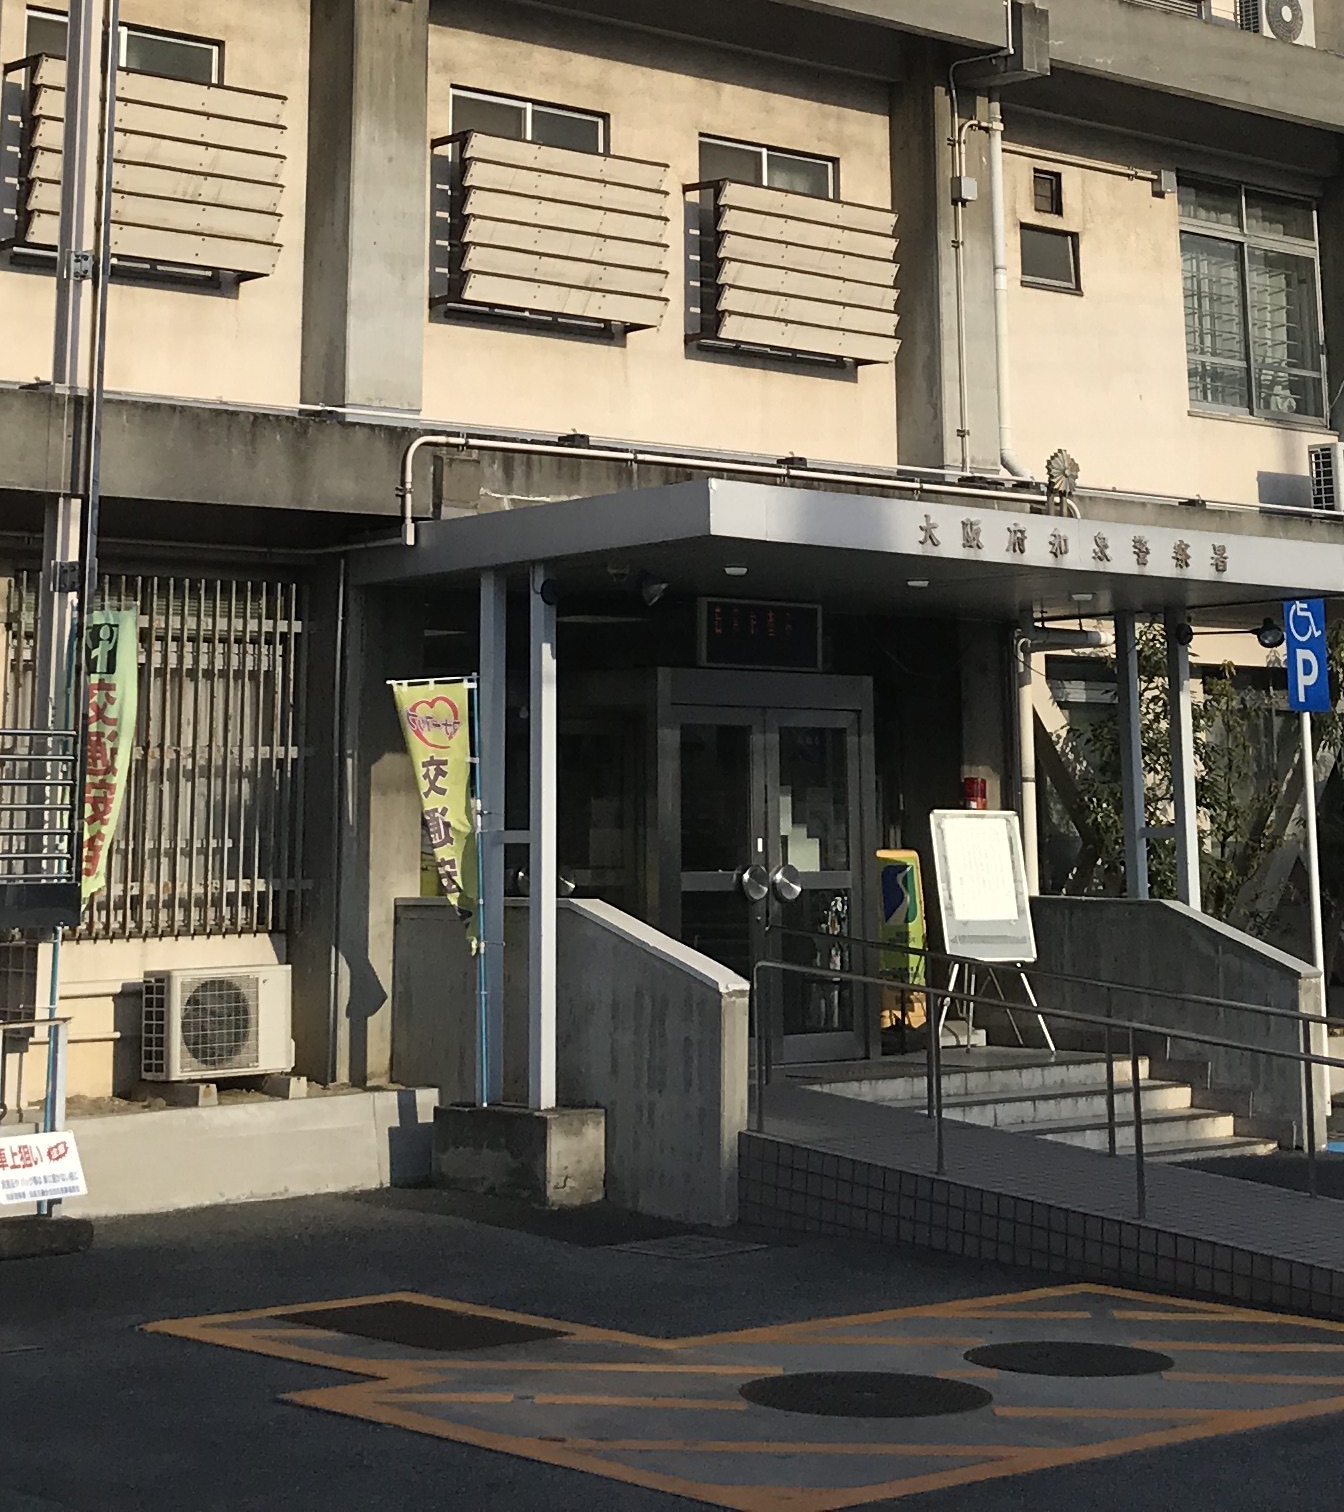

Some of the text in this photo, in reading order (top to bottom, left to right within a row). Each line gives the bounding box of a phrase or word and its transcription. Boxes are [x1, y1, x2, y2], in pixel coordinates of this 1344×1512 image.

[918, 514, 1229, 573] 大阪府和泉警察署
[1296, 648, 1319, 703] P
